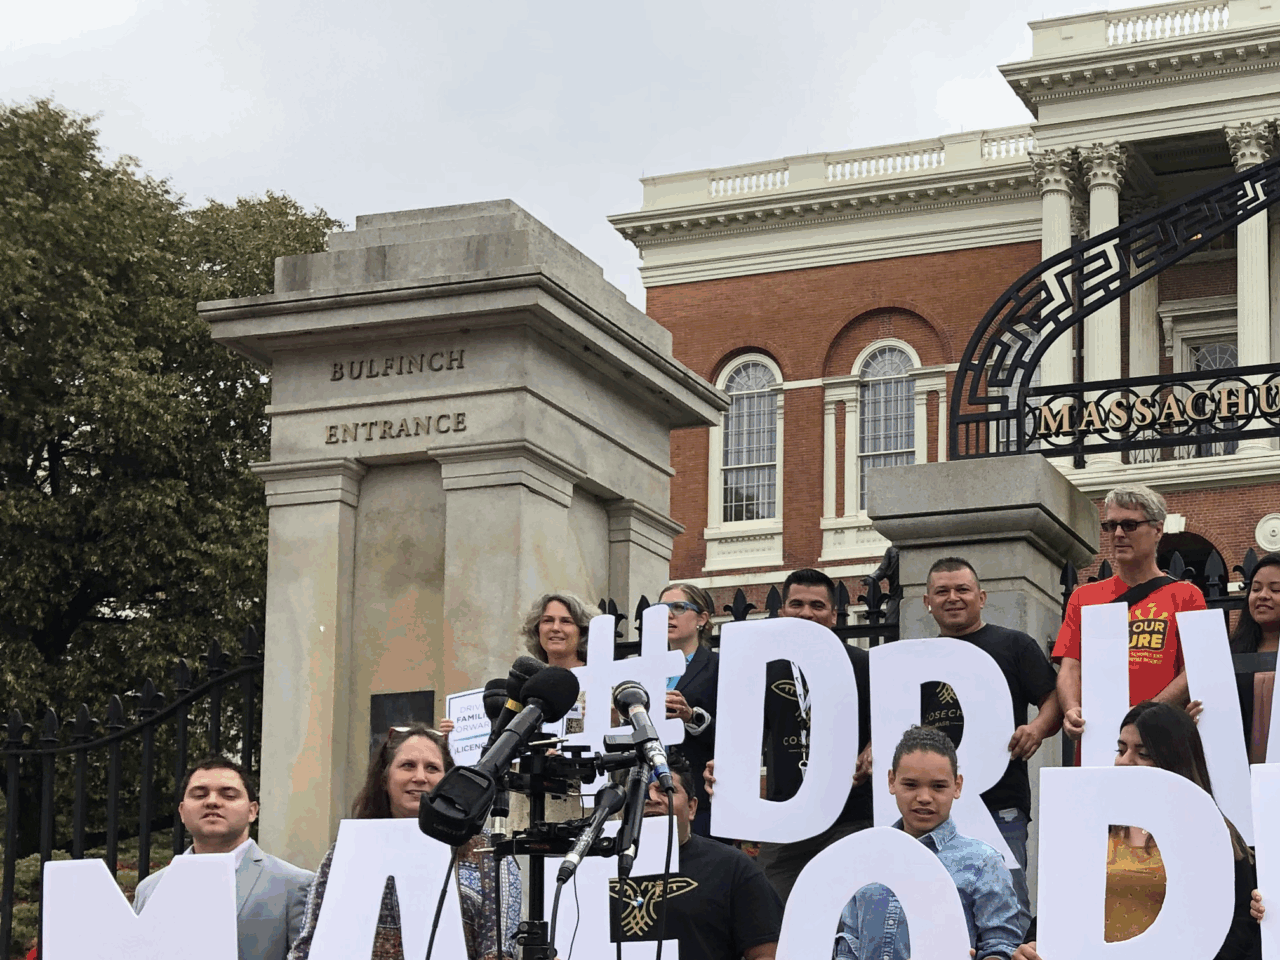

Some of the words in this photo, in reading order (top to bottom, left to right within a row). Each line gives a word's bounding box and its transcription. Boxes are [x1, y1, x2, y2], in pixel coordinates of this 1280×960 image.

[330, 350, 465, 382] BULFINCH
[325, 412, 467, 444] ENTRANCE
[1133, 621, 1165, 632] OUR
